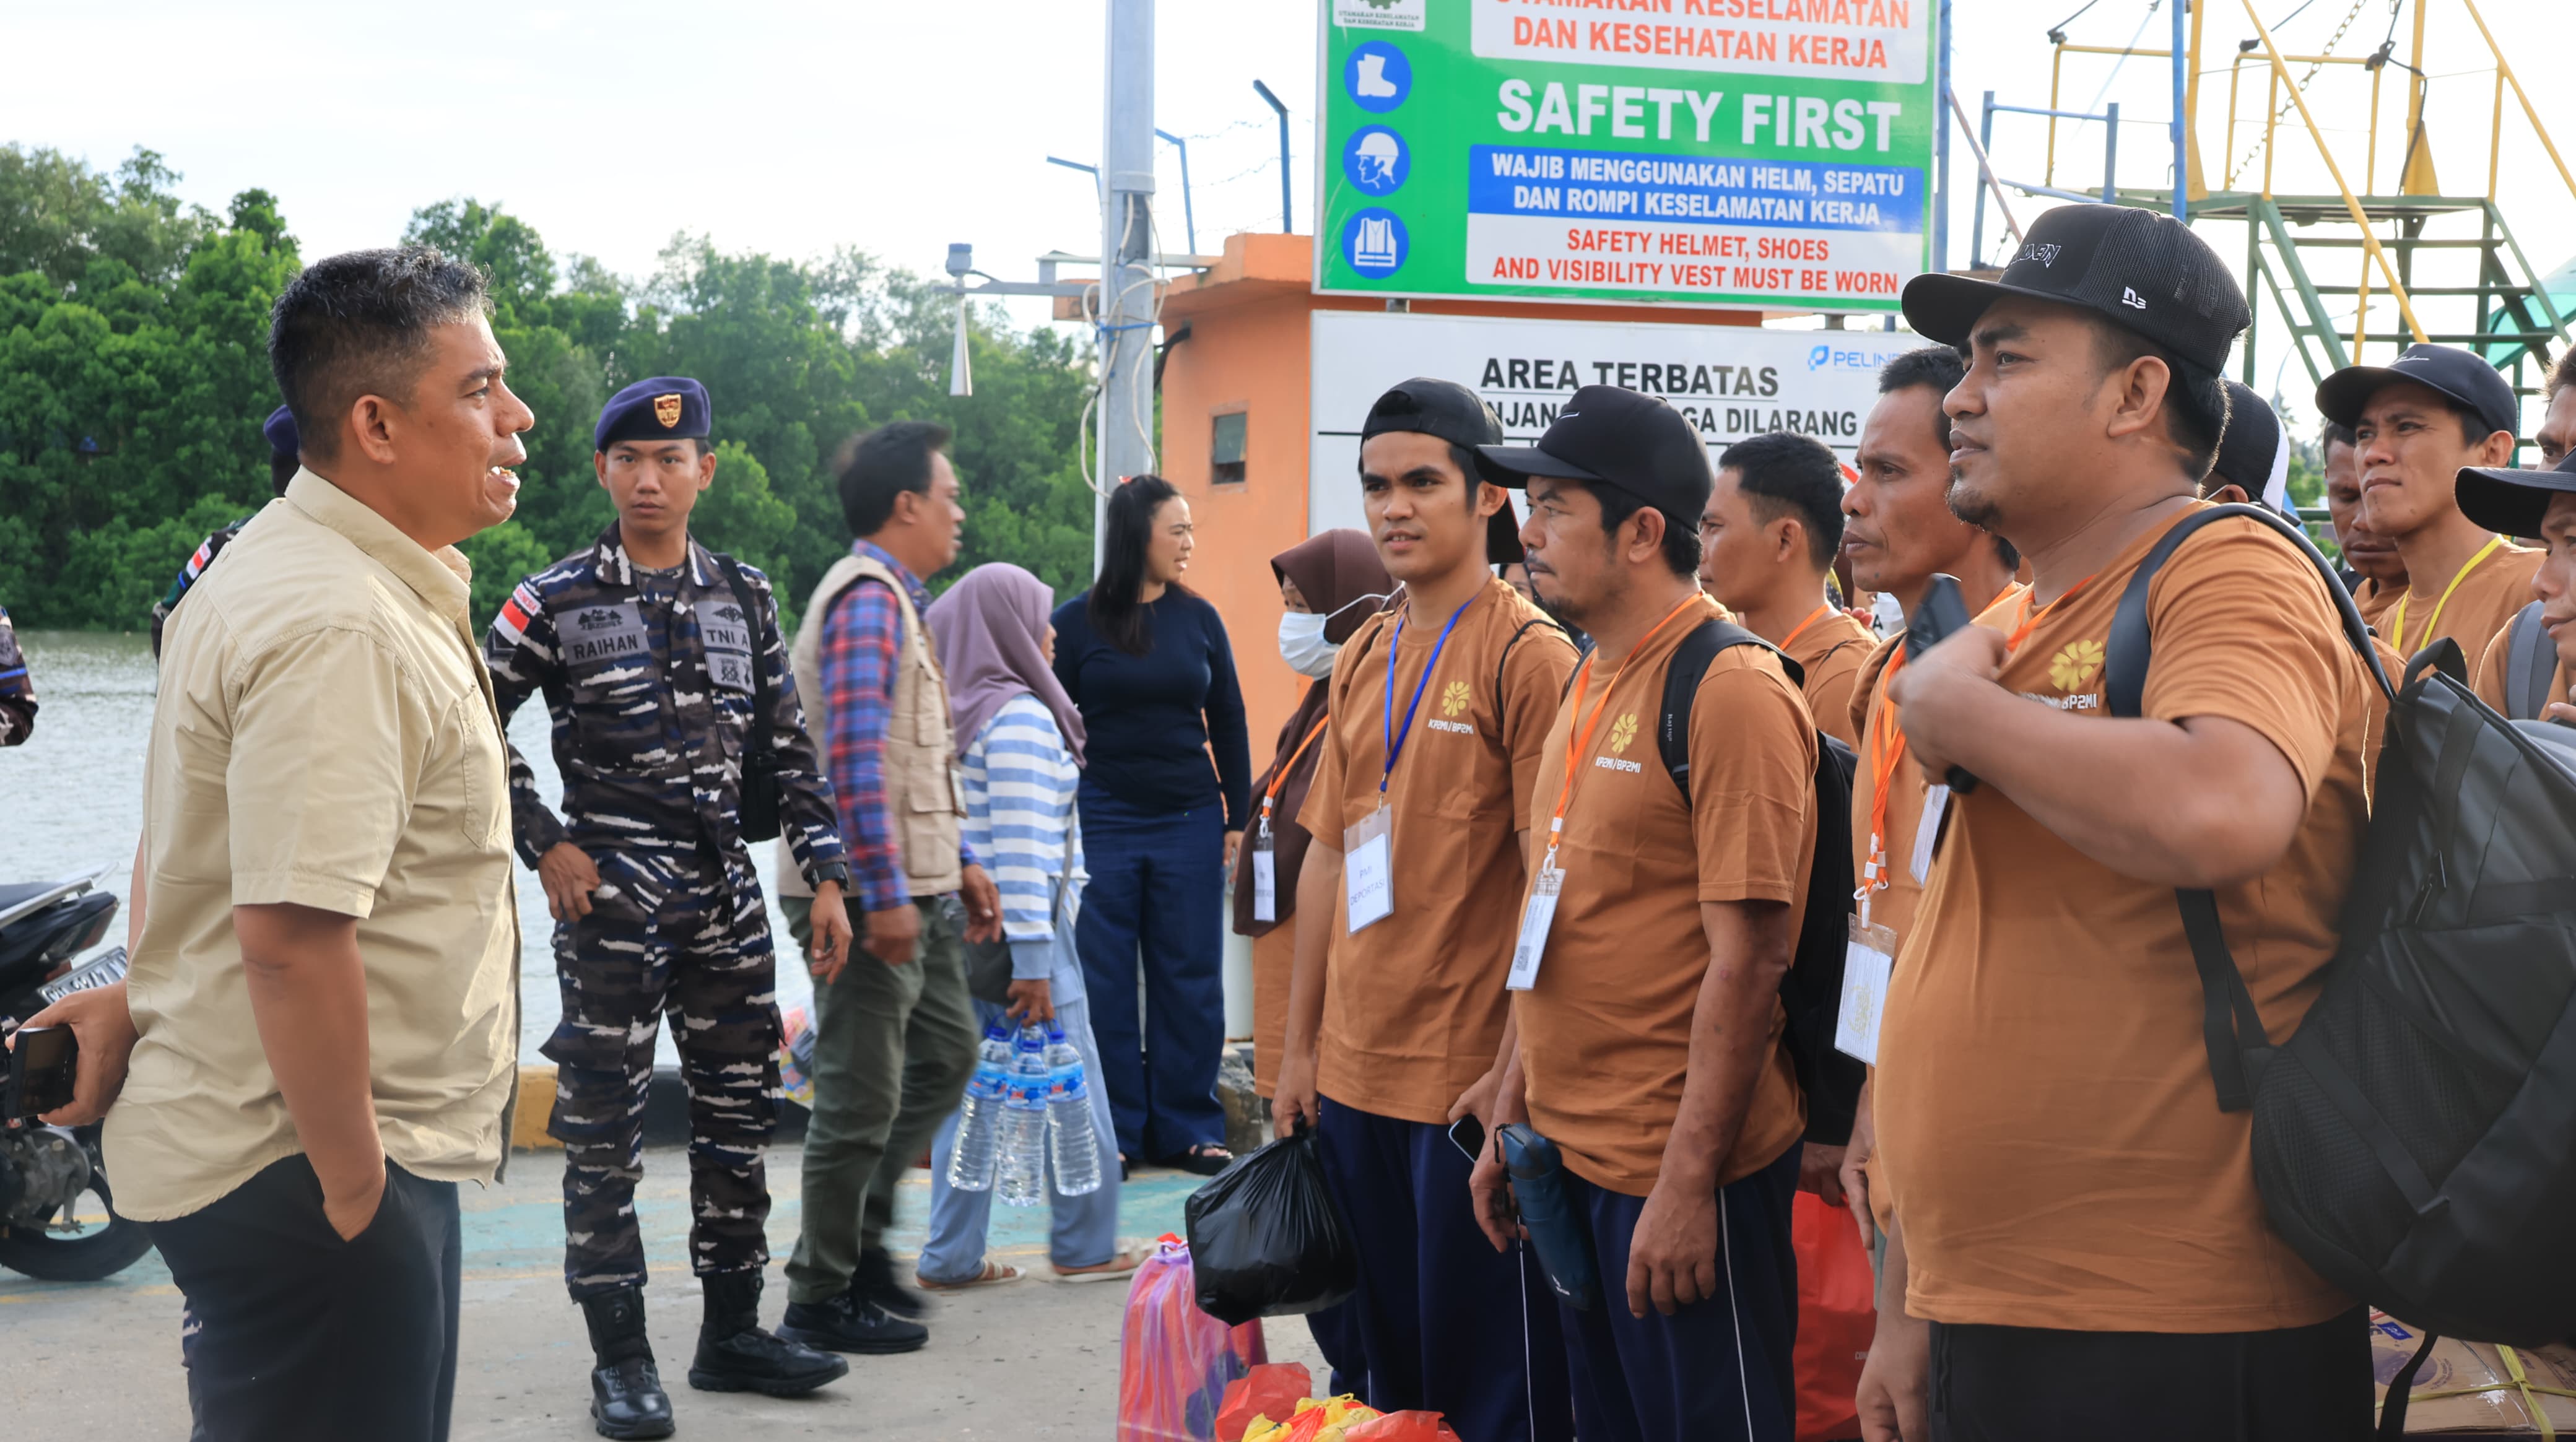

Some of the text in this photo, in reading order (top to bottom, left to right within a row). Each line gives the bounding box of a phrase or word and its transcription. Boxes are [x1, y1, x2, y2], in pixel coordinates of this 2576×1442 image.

[1684, 0, 1908, 28] KESELAMATAN
[1514, 16, 1887, 68] DAN KESEHATAN KERJA
[1497, 79, 1902, 152] SAFETY FIRST
[1492, 153, 1904, 197] WAJIB MENGGUNAKAN HELM, SEPATU
[1514, 185, 1881, 225] DAN ROMPI KESELAMATAN KERJA
[1567, 228, 1829, 263] SAFETY HELMET, SHOES
[1493, 256, 1898, 294] AND VISIBILITY VEST MUST BE WORN
[1481, 357, 1778, 397] AREA TERBATAS
[1682, 406, 1717, 433] GA
[1726, 408, 1857, 437] DILARANG
[573, 633, 638, 660] RAIHAN
[706, 628, 735, 644] TNI
